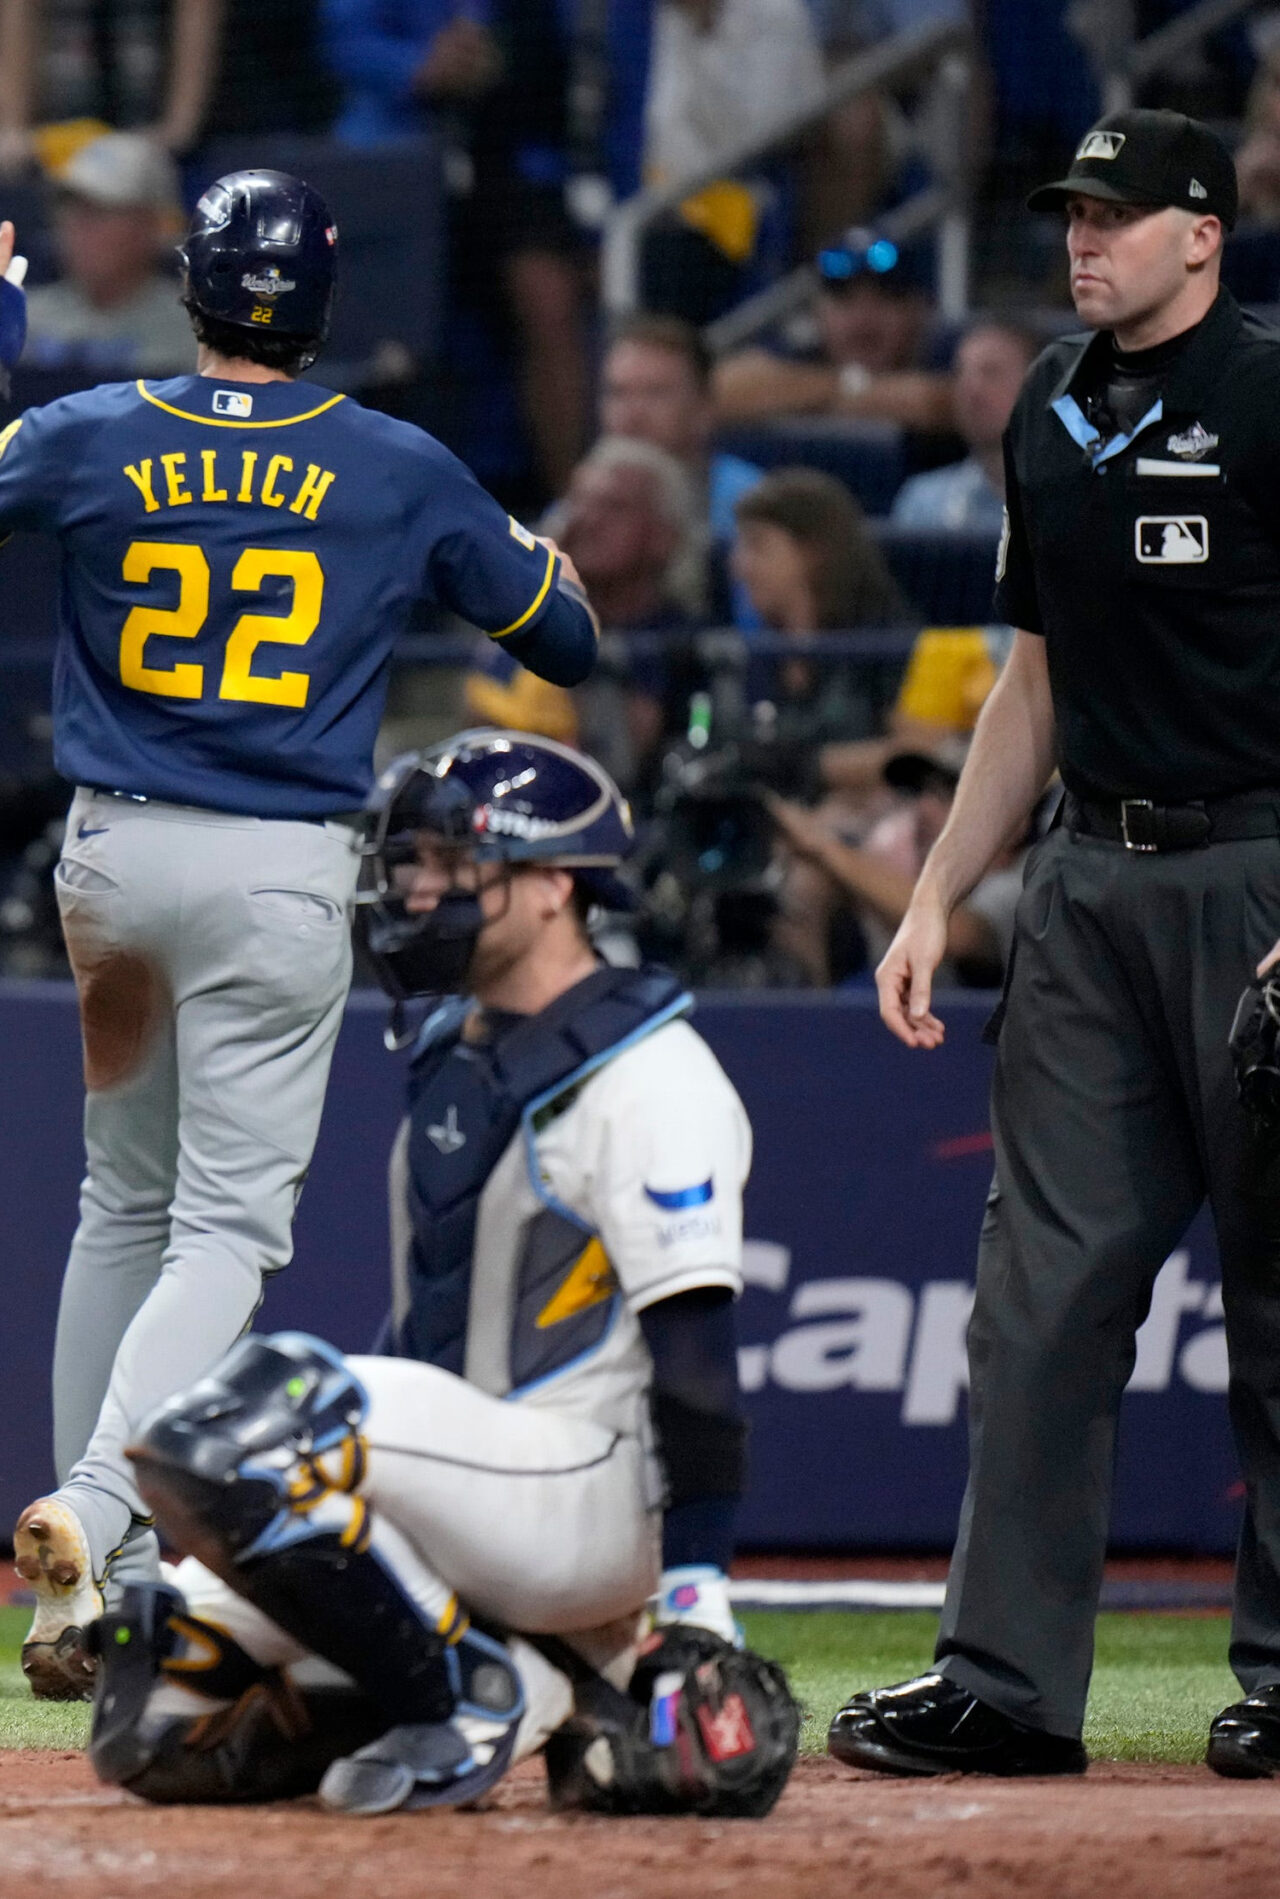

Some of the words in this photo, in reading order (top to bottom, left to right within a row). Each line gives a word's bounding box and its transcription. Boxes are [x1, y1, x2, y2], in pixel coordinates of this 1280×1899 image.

[251, 305, 274, 324] 22
[124, 450, 336, 520] YELICH
[120, 540, 325, 709] 22
